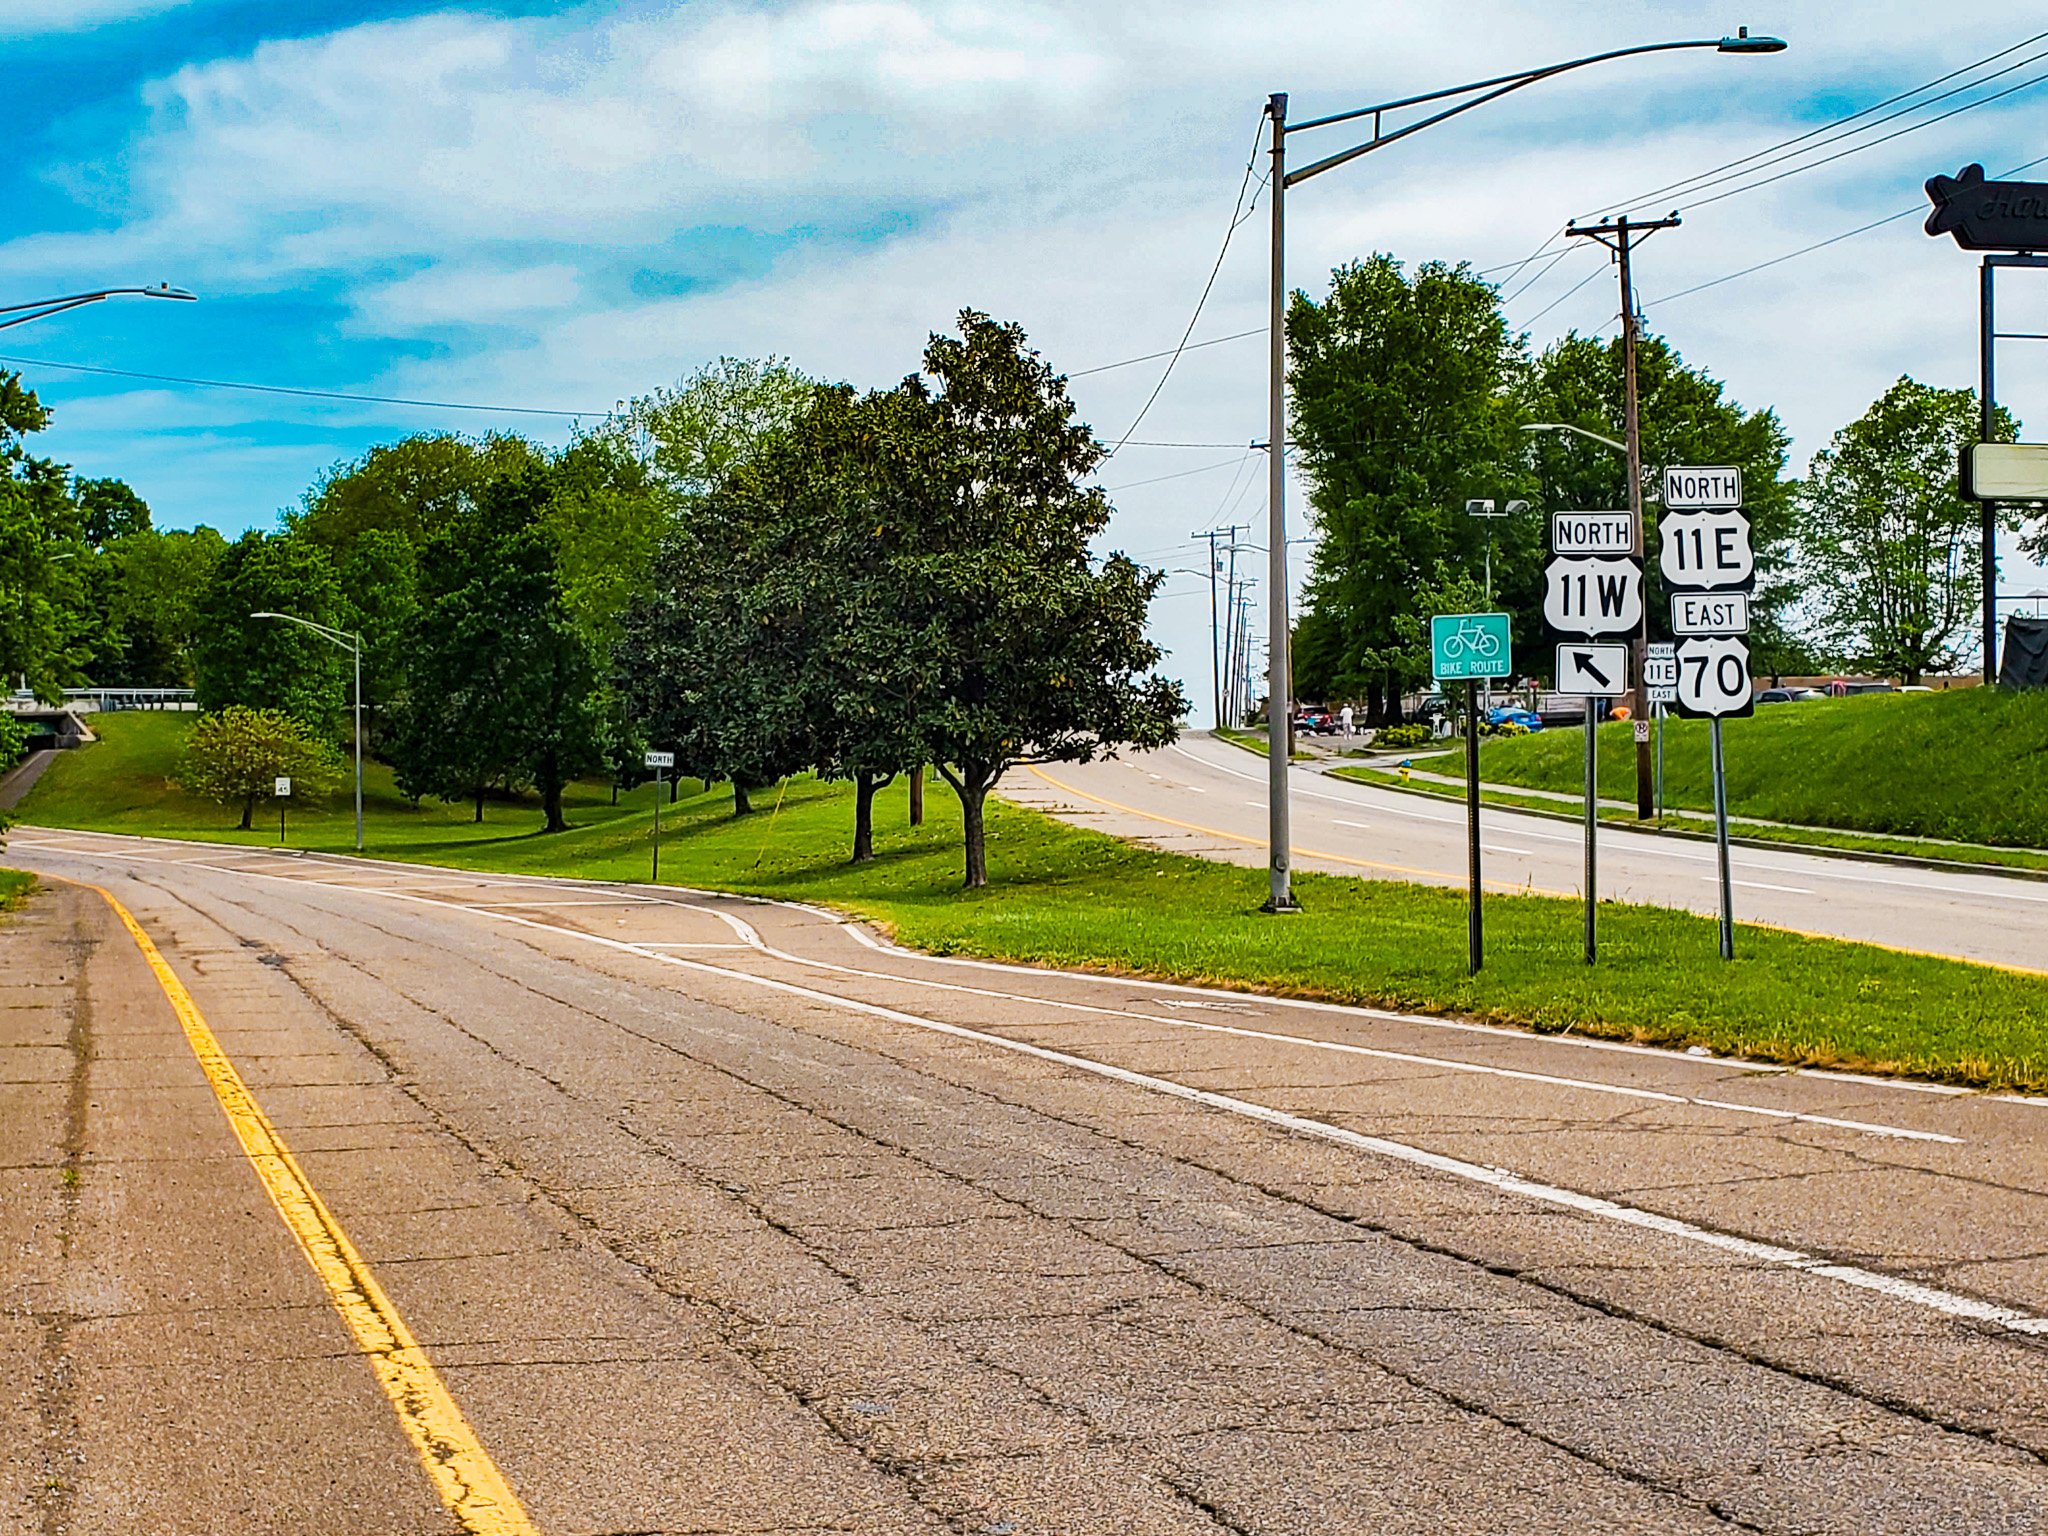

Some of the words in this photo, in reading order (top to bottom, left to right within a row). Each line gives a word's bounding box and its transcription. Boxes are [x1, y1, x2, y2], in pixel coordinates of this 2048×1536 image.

[1669, 475, 1736, 499] NORTH
[1559, 521, 1629, 545] NORTH
[1673, 527, 1741, 571] 11E
[1561, 574, 1628, 617] 11W
[1685, 601, 1735, 626] EAST
[1649, 647, 1674, 655] NORTH
[1441, 662, 1462, 675] BIKE
[1471, 660, 1504, 673] ROUTE
[1649, 664, 1674, 680] 11E
[1683, 655, 1744, 698] 70
[1652, 691, 1671, 699] EAST
[646, 754, 672, 763] NORTH
